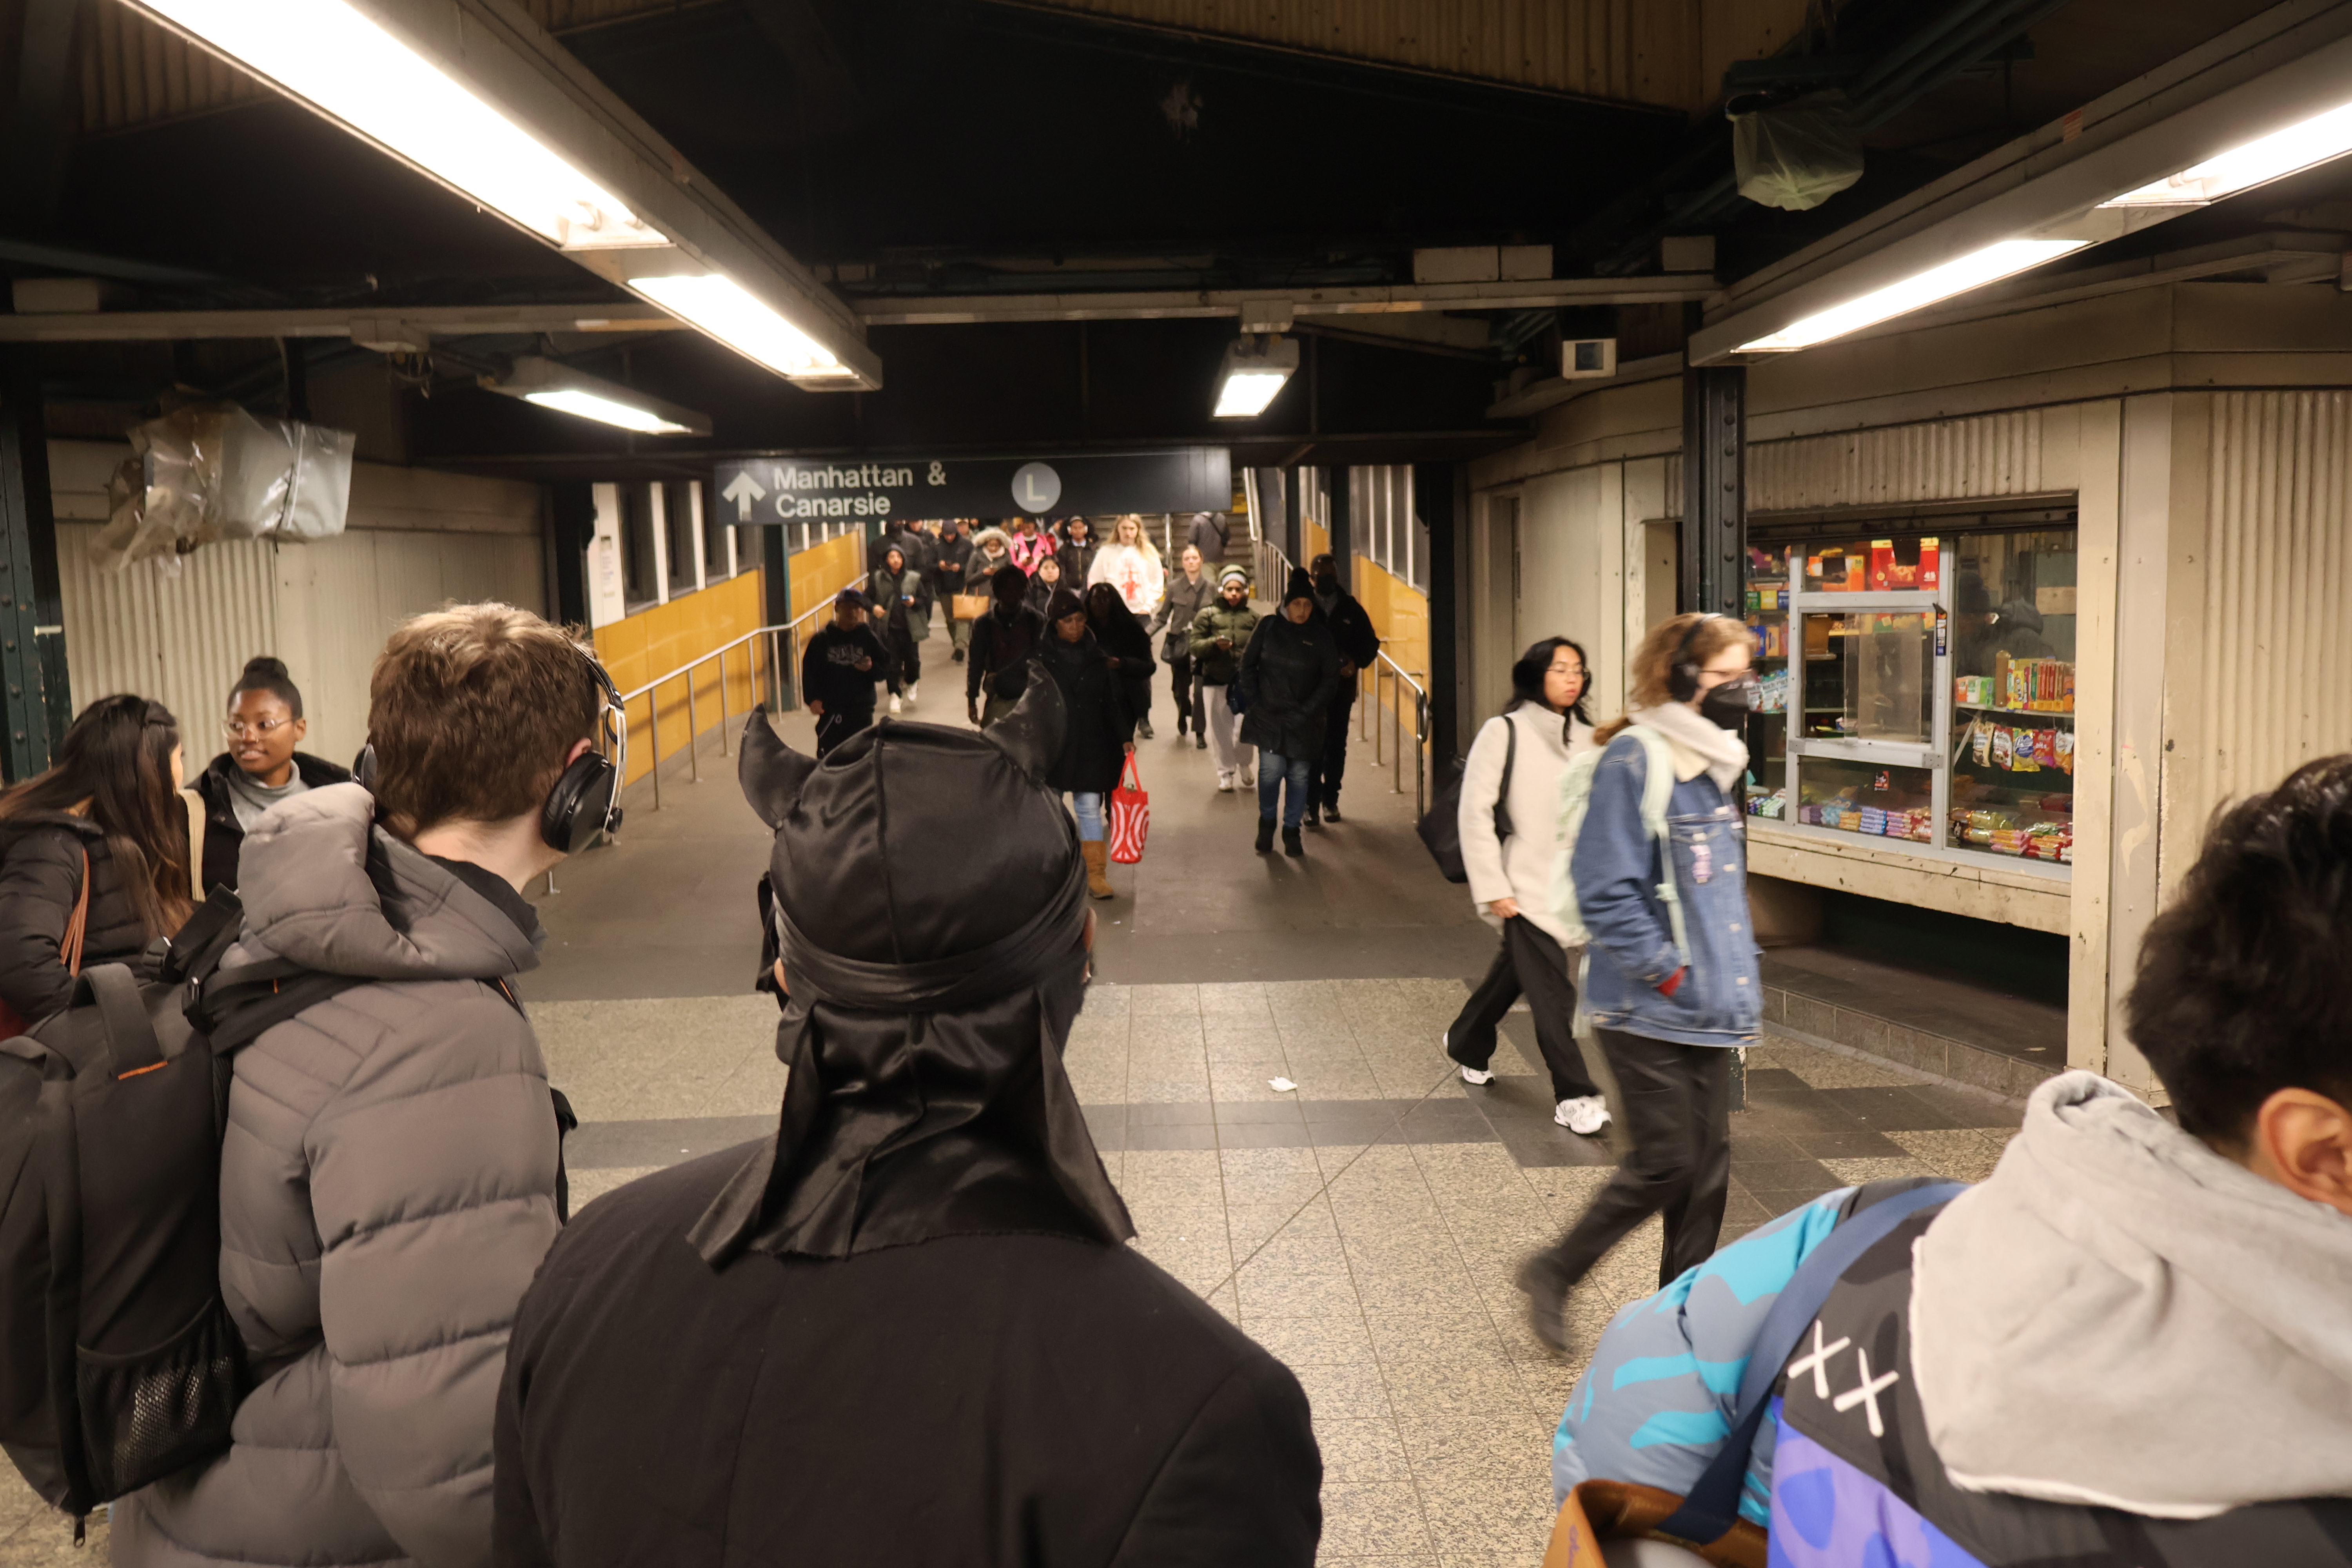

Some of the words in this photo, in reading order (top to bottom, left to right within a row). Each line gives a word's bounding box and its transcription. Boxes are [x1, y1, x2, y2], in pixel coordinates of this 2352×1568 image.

[773, 465, 913, 490] Manhattan
[927, 460, 947, 486] &
[1026, 474, 1047, 501] L
[775, 492, 891, 518] Canarsie
